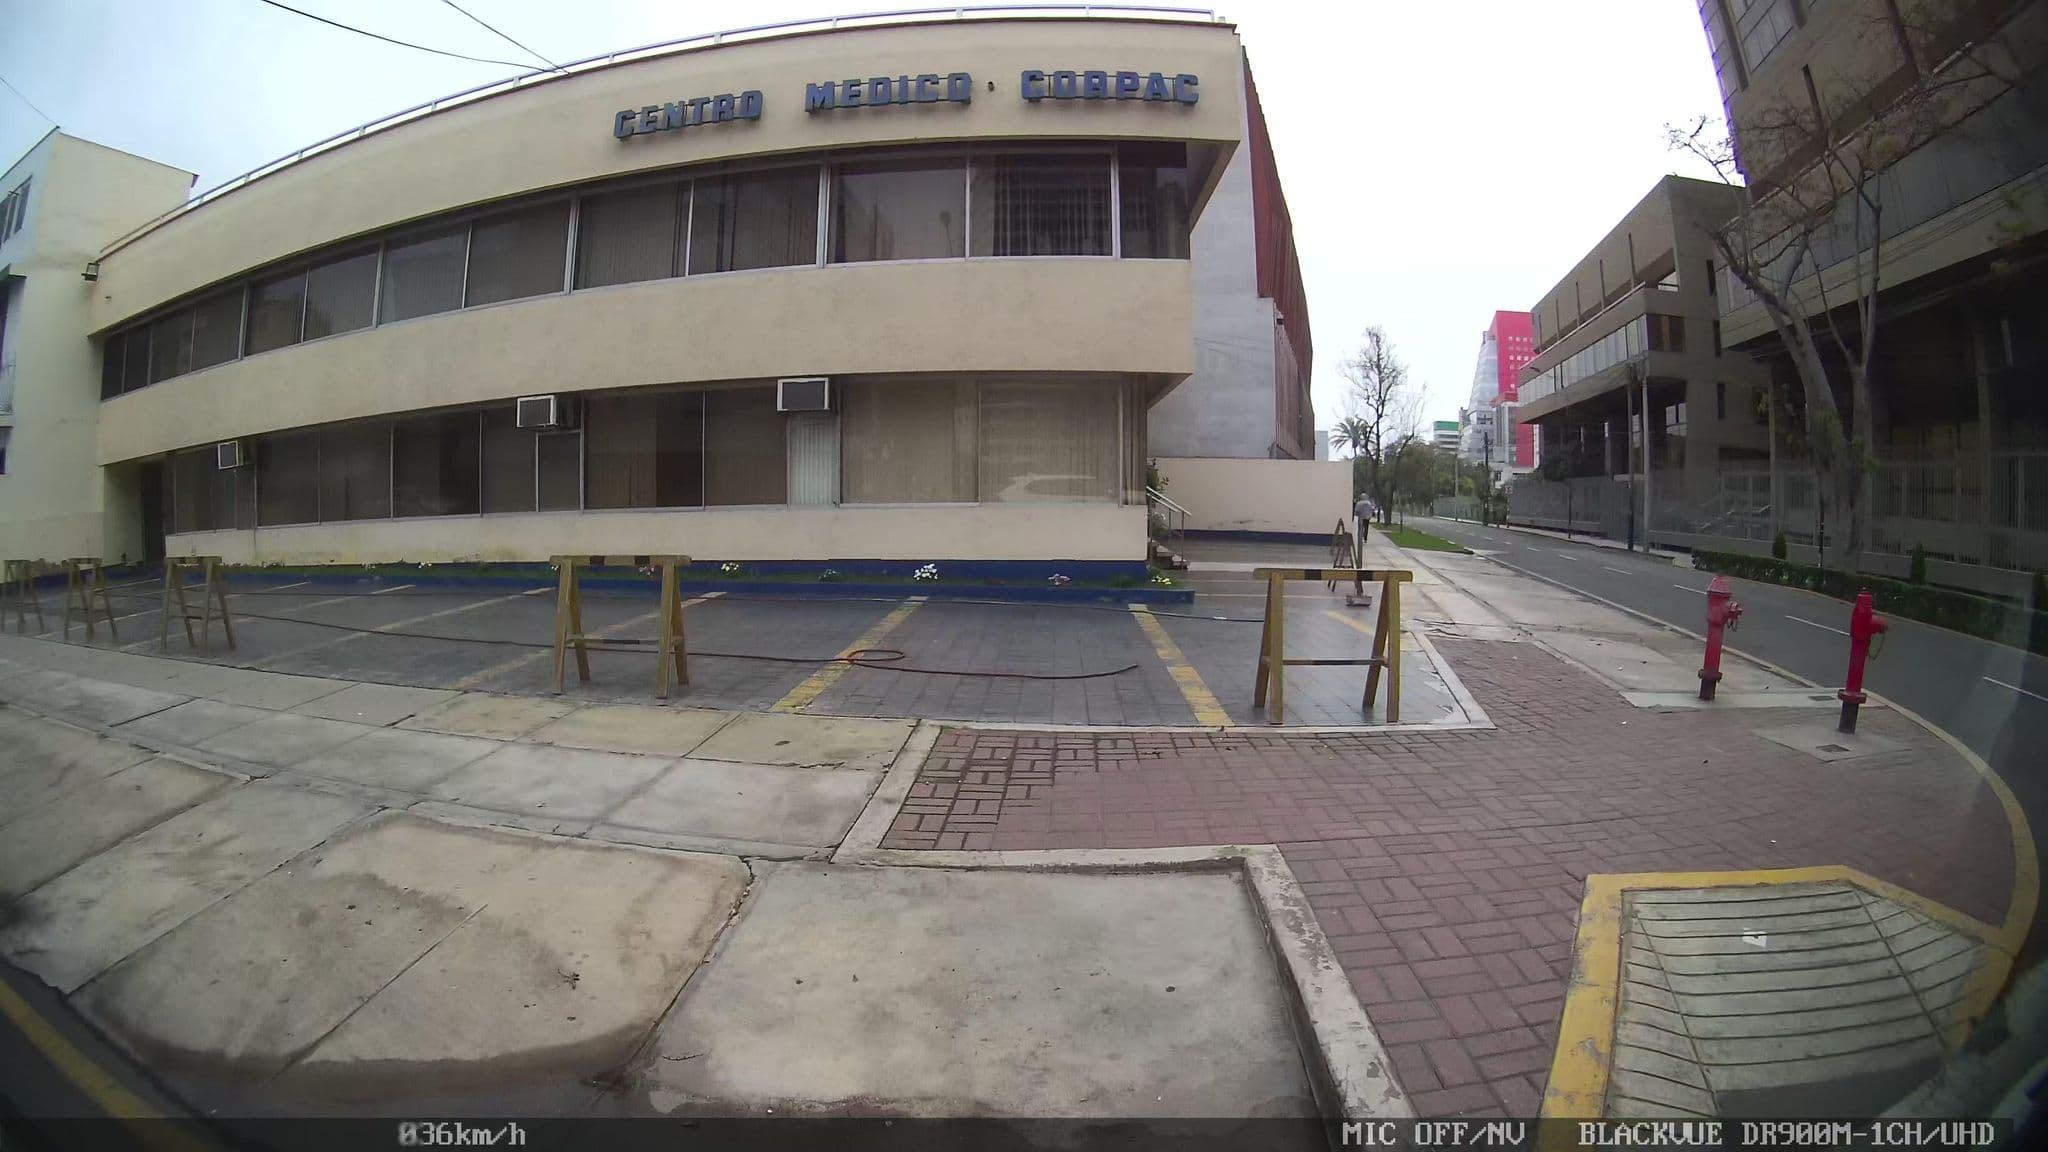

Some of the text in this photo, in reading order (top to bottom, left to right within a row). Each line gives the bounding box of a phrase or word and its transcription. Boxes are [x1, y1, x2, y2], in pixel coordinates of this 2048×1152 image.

[613, 70, 1200, 139] CENTRO MEDICO CORPAC
